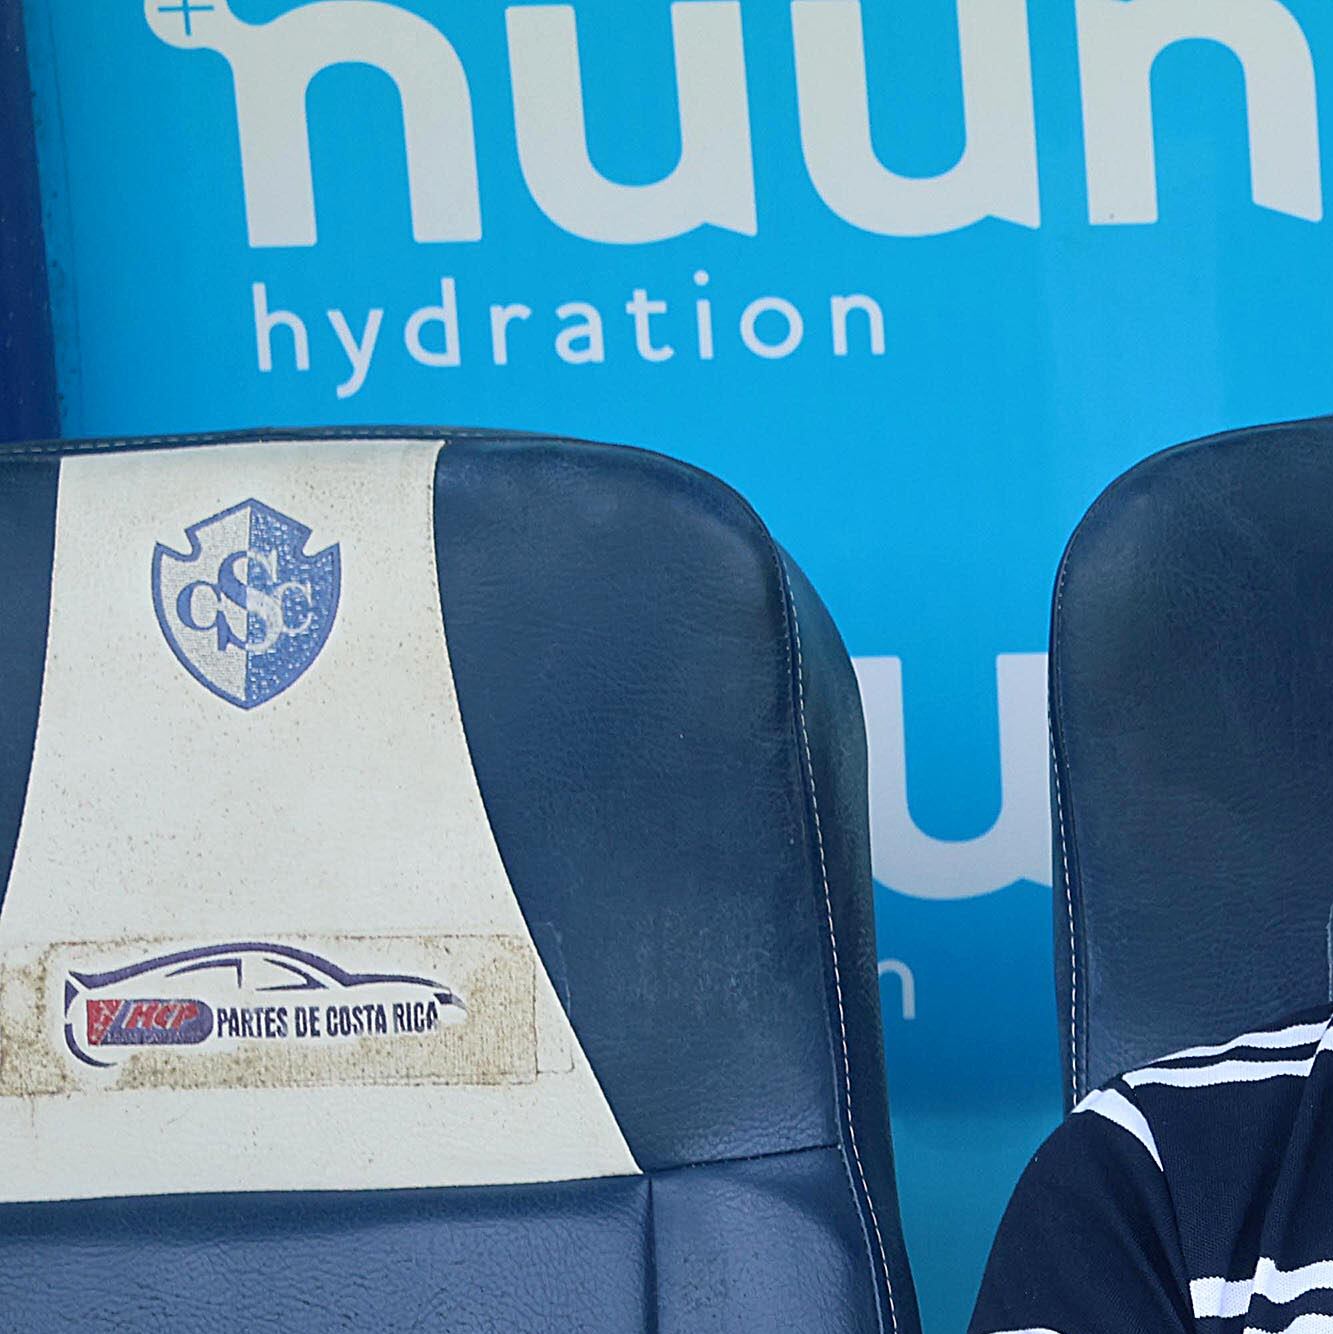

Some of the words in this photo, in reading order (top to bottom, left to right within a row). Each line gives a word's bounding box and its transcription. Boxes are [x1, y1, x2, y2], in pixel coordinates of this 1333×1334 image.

[146, 0, 1323, 248] nuun
[252, 270, 886, 399] hydration
[216, 1007, 288, 1038] PARTES
[295, 1006, 320, 1038] DE
[325, 1003, 388, 1037] COSTA
[393, 1001, 440, 1034] RICA
